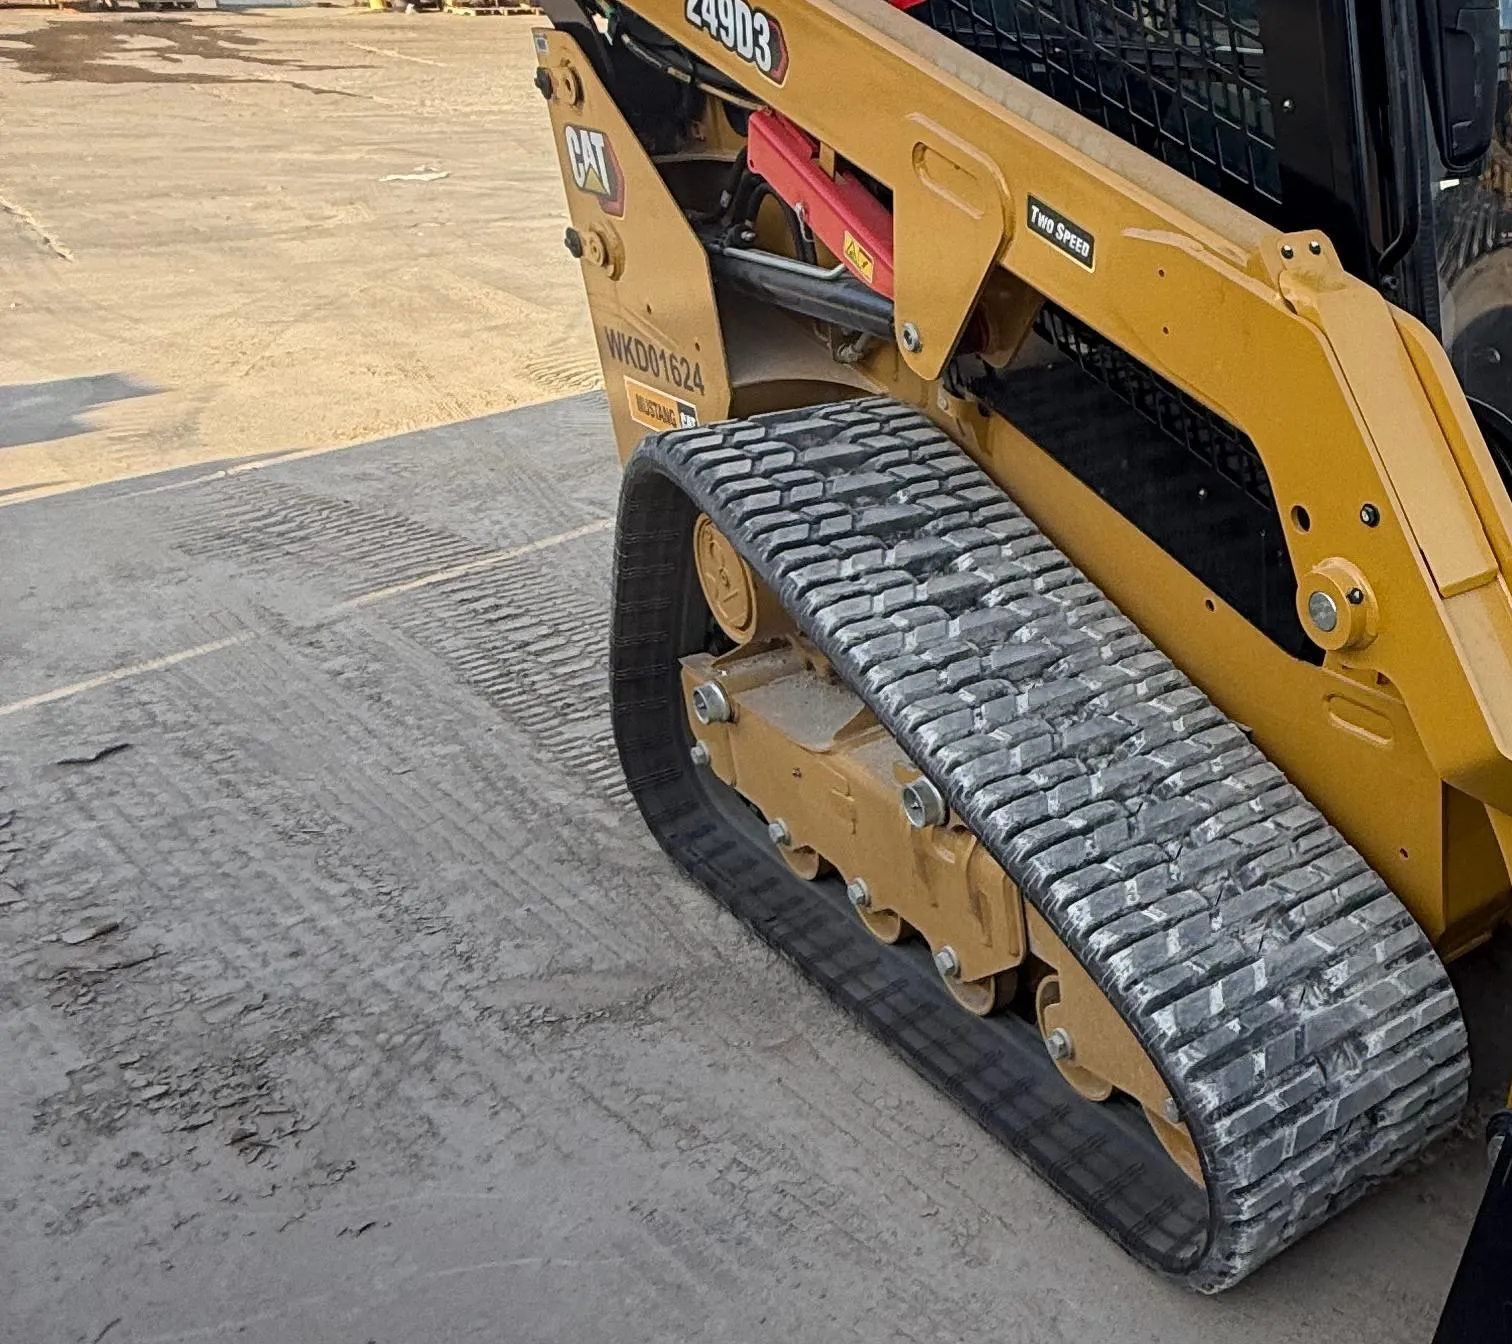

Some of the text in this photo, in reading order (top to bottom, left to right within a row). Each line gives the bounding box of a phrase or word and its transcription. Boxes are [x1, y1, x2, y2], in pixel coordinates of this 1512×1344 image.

[564, 124, 612, 197] CAT
[1031, 204, 1090, 258] TWO SPEED
[604, 325, 705, 396] WKD01624
